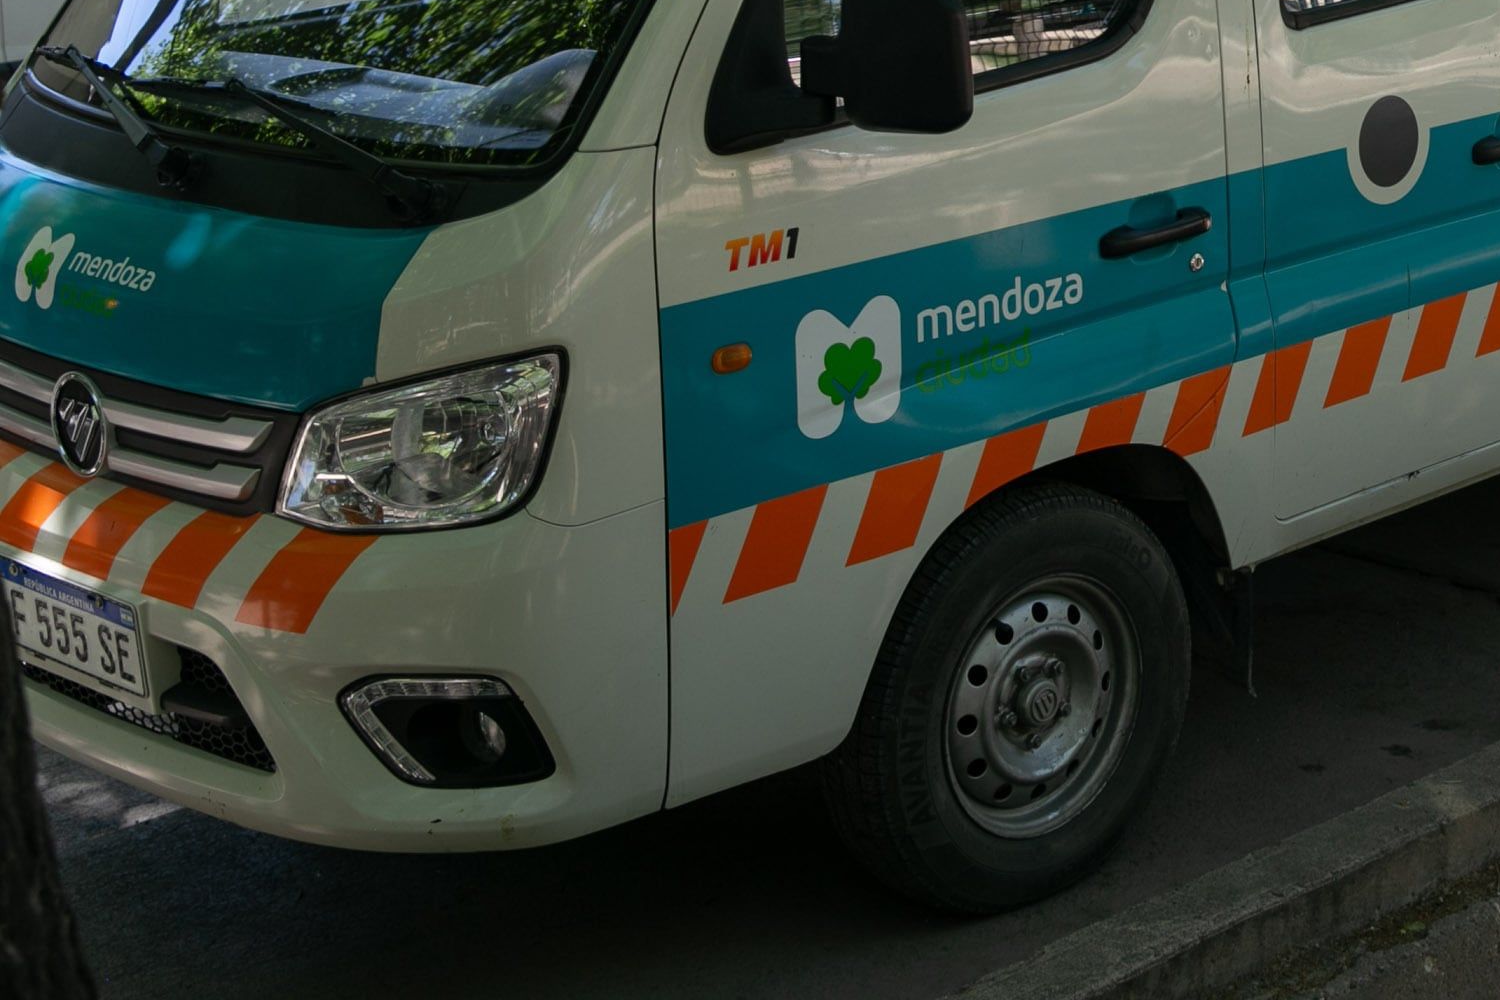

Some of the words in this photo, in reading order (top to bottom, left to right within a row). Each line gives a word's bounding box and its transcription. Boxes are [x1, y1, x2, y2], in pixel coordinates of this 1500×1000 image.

[68, 251, 156, 292] mendoza
[725, 227, 799, 272] TM1
[916, 272, 1084, 343] mendoza
[915, 328, 1033, 393] ciudad
[58, 591, 94, 611] ARGENTINA
[35, 598, 88, 663] 555
[97, 623, 136, 684] SE
